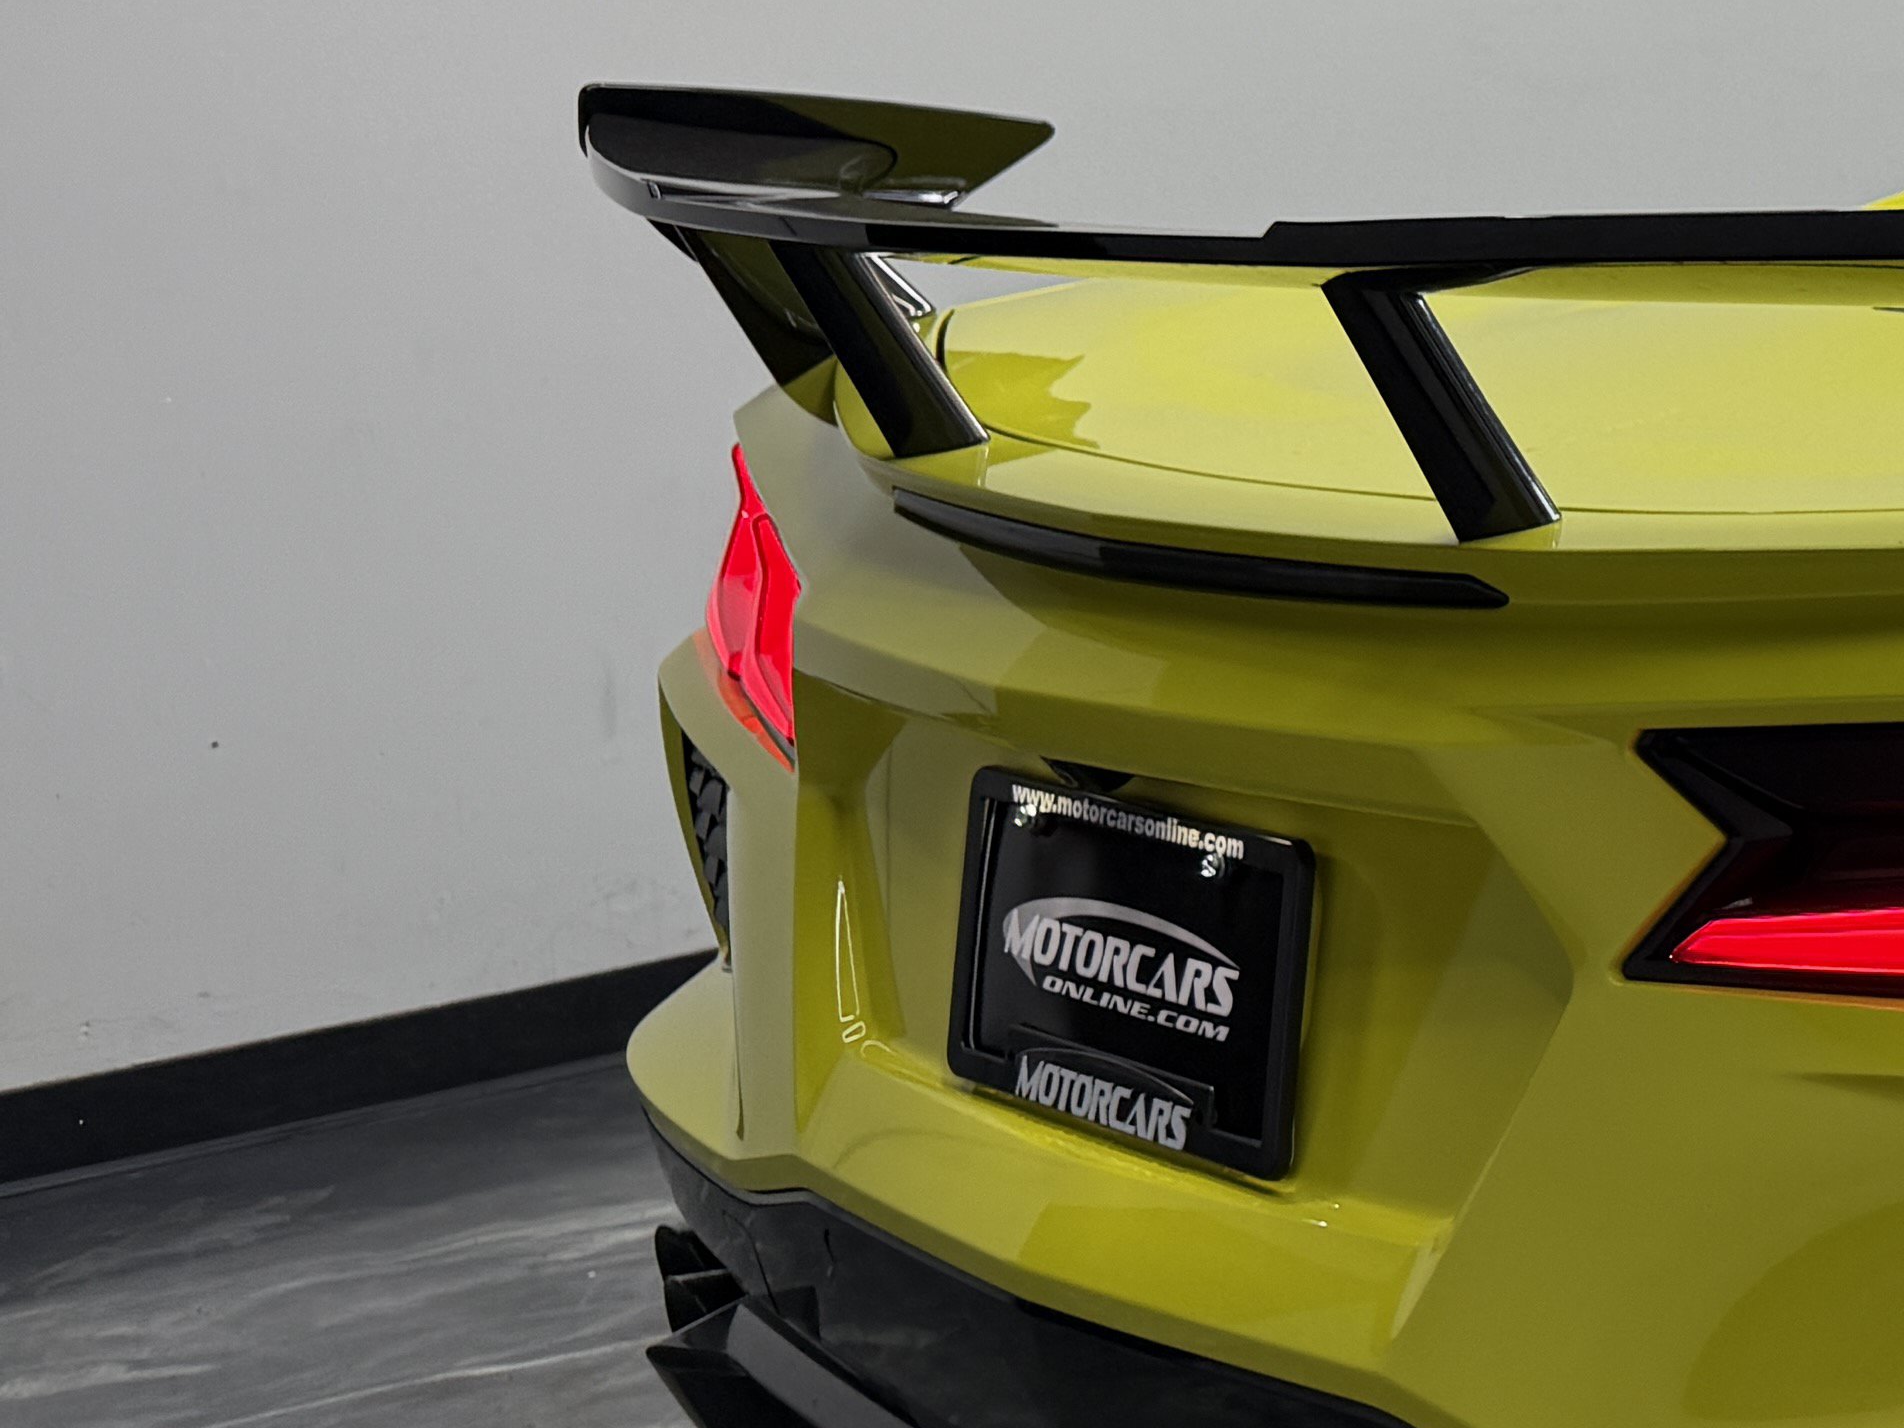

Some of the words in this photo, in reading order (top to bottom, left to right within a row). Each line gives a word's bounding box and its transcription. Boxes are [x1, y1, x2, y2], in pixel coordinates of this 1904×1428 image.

[1012, 784, 1244, 859] www.motorcarsonline.com
[1004, 907, 1240, 1017] MOTORCARS
[1042, 975, 1230, 1042] ONLINE.COM
[1015, 1055, 1192, 1151] MOTORCARS
